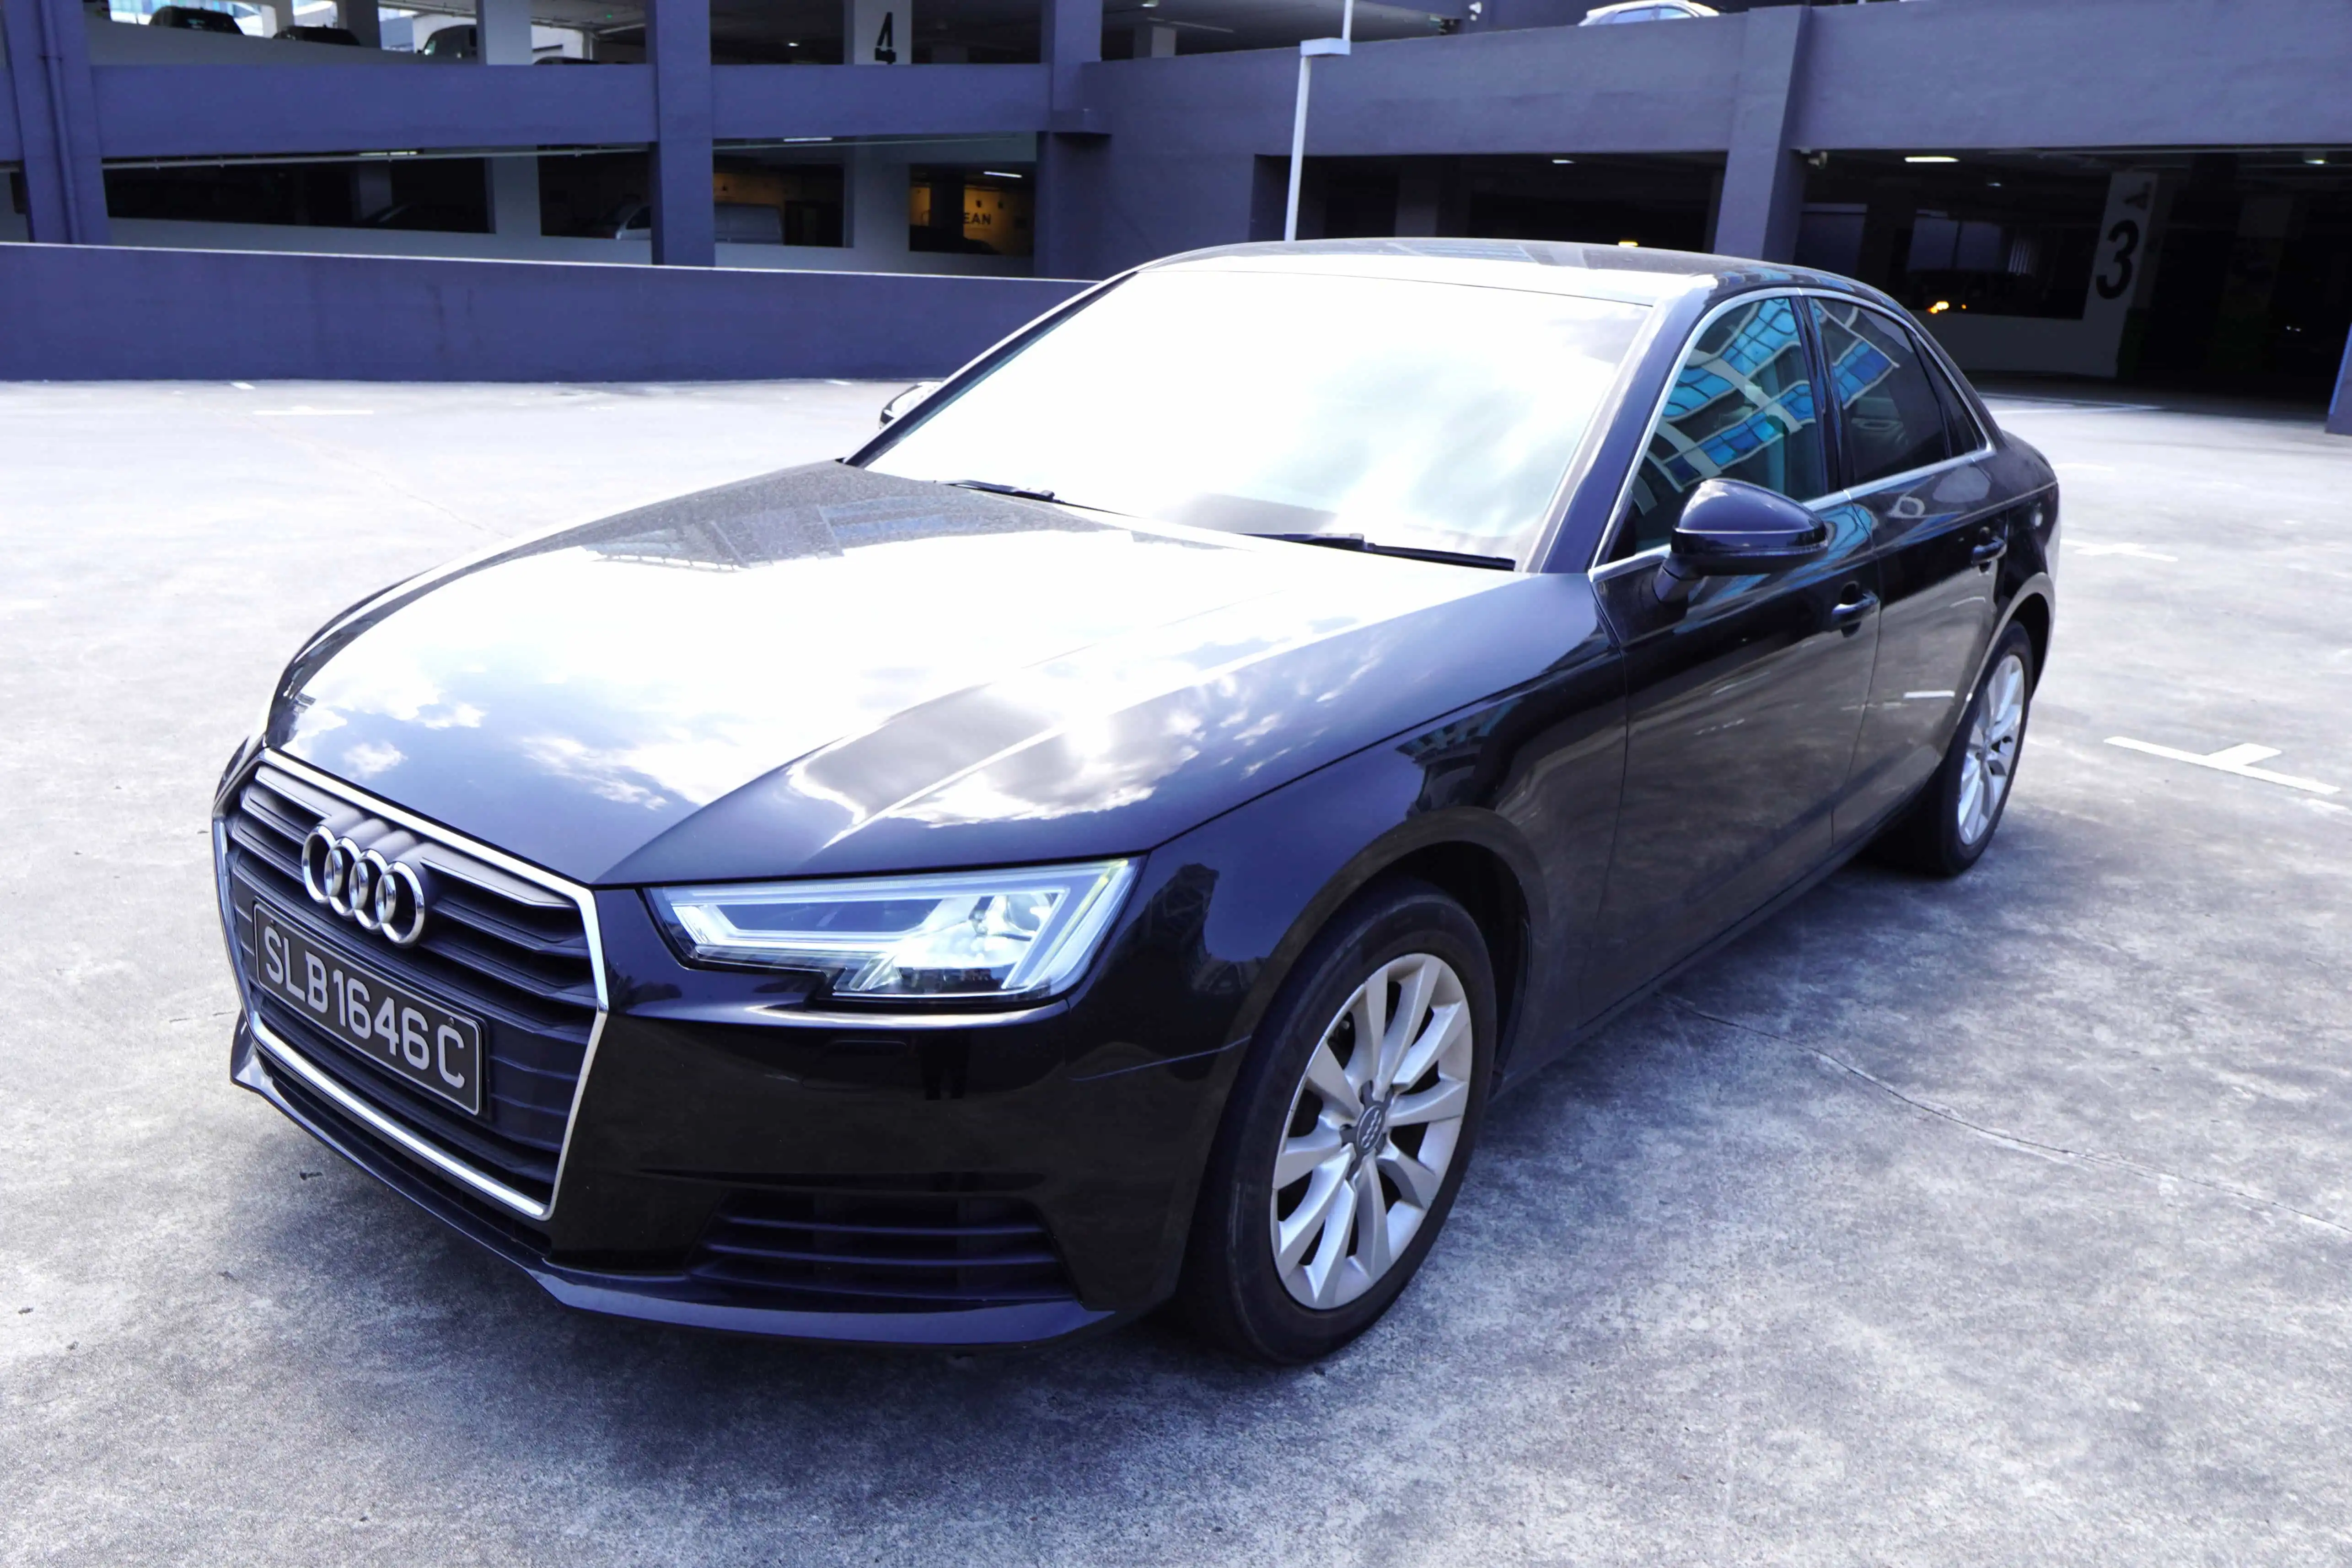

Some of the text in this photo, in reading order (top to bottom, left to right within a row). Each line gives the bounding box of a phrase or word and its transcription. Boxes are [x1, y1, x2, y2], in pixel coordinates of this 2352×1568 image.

[875, 11, 897, 64] 4
[2096, 220, 2139, 299] 3
[264, 925, 465, 1089] SLB1646C
